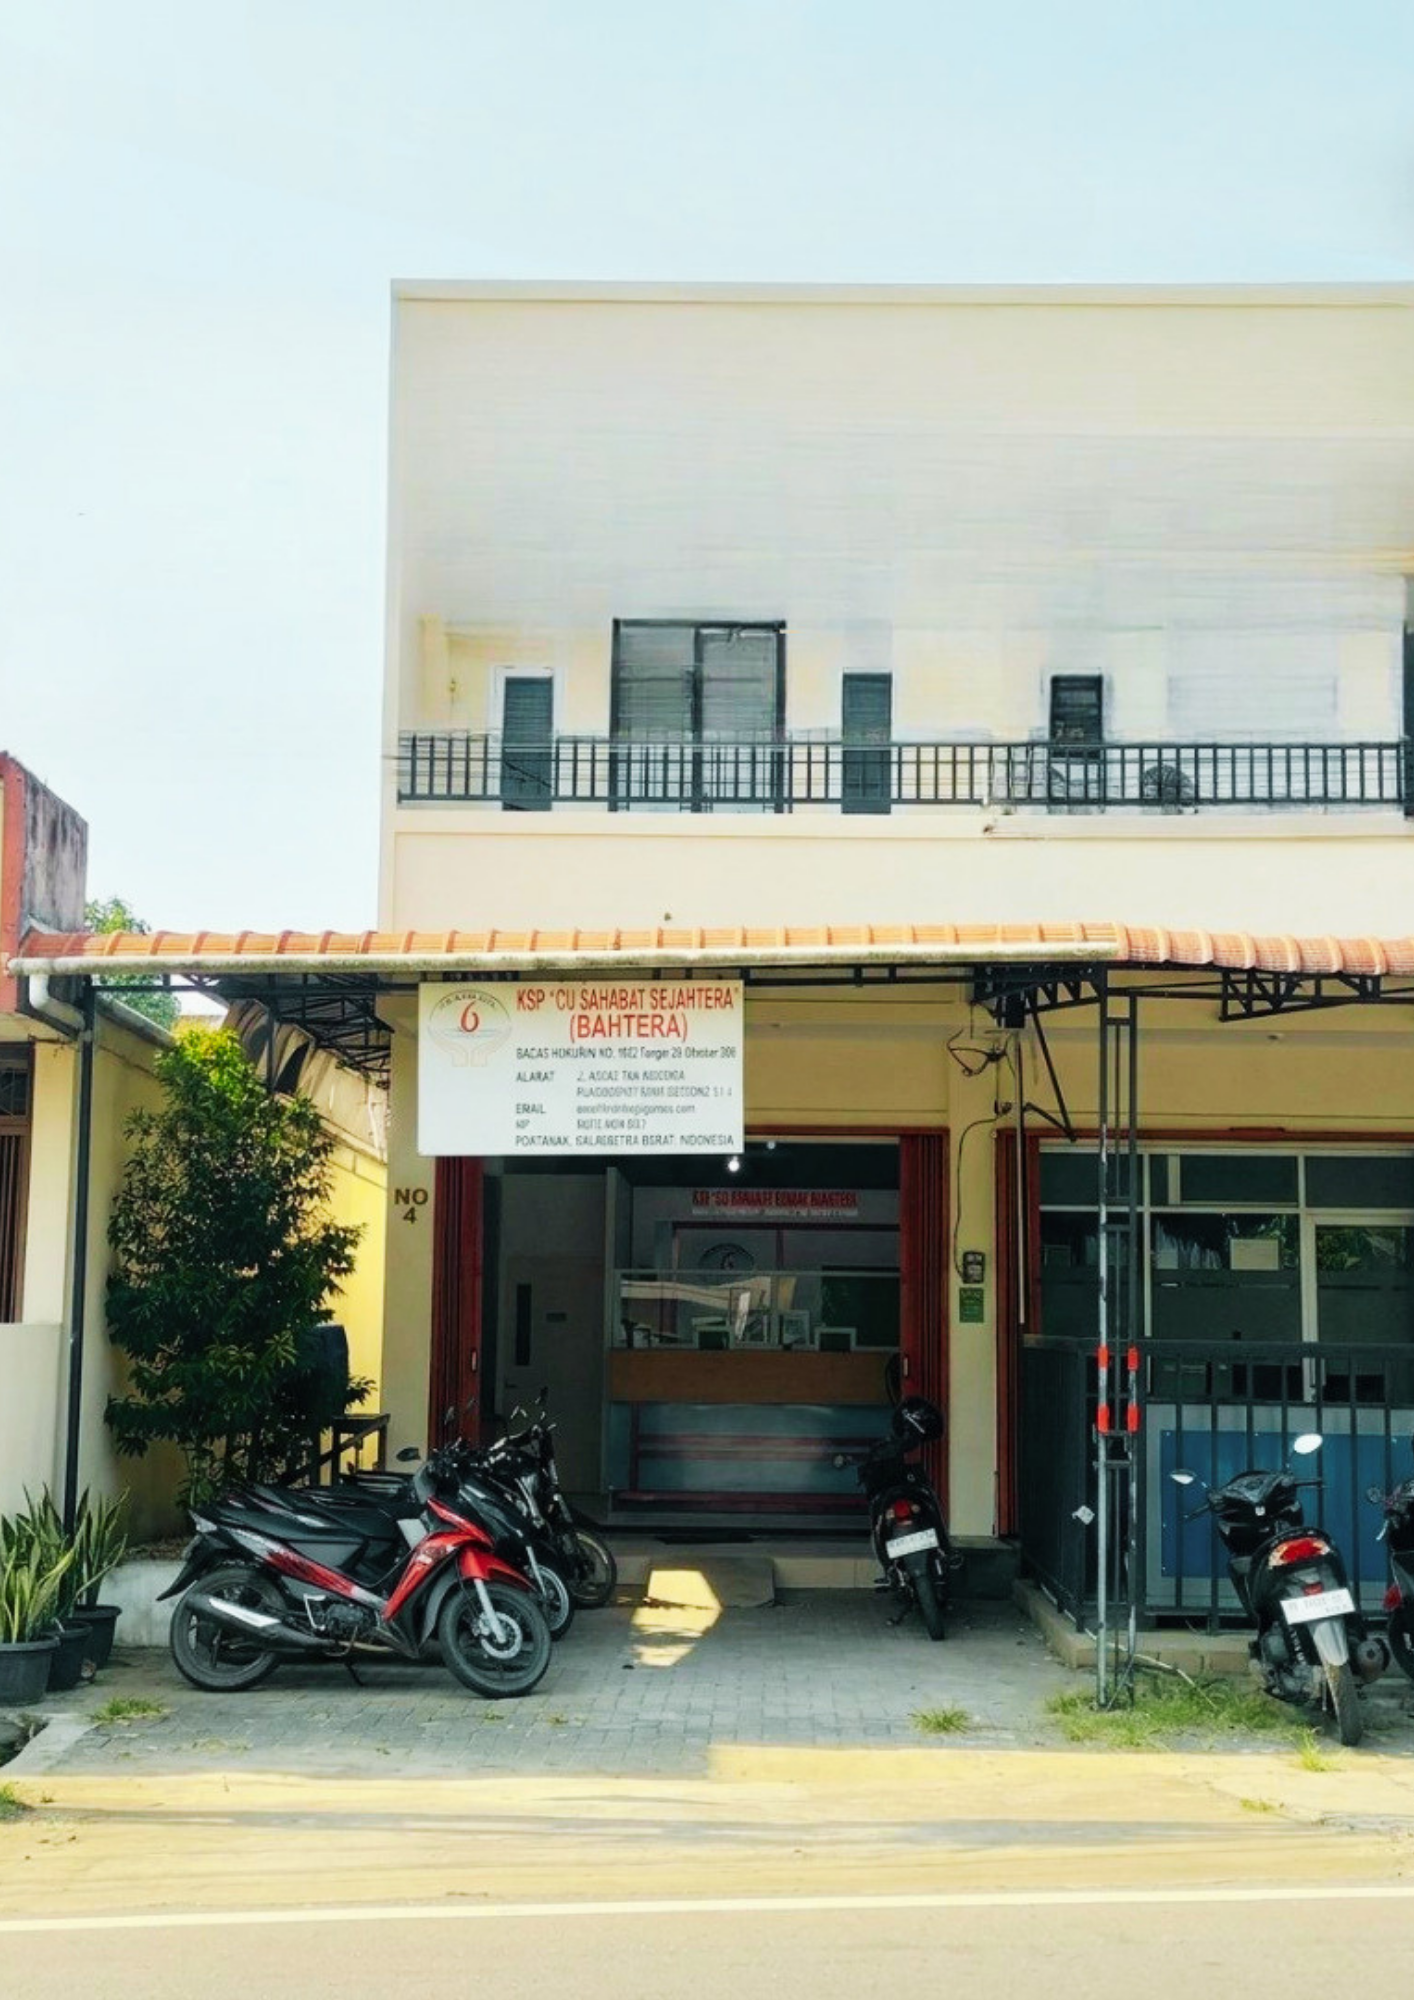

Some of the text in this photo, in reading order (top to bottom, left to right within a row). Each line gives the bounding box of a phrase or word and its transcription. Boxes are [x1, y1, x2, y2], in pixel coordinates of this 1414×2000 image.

[517, 988, 545, 1011] KSP
[579, 988, 645, 1010] SAHABAT
[569, 1013, 688, 1043] (BAHTERA)
[394, 1188, 428, 1205] NO
[403, 1206, 417, 1225] 4
